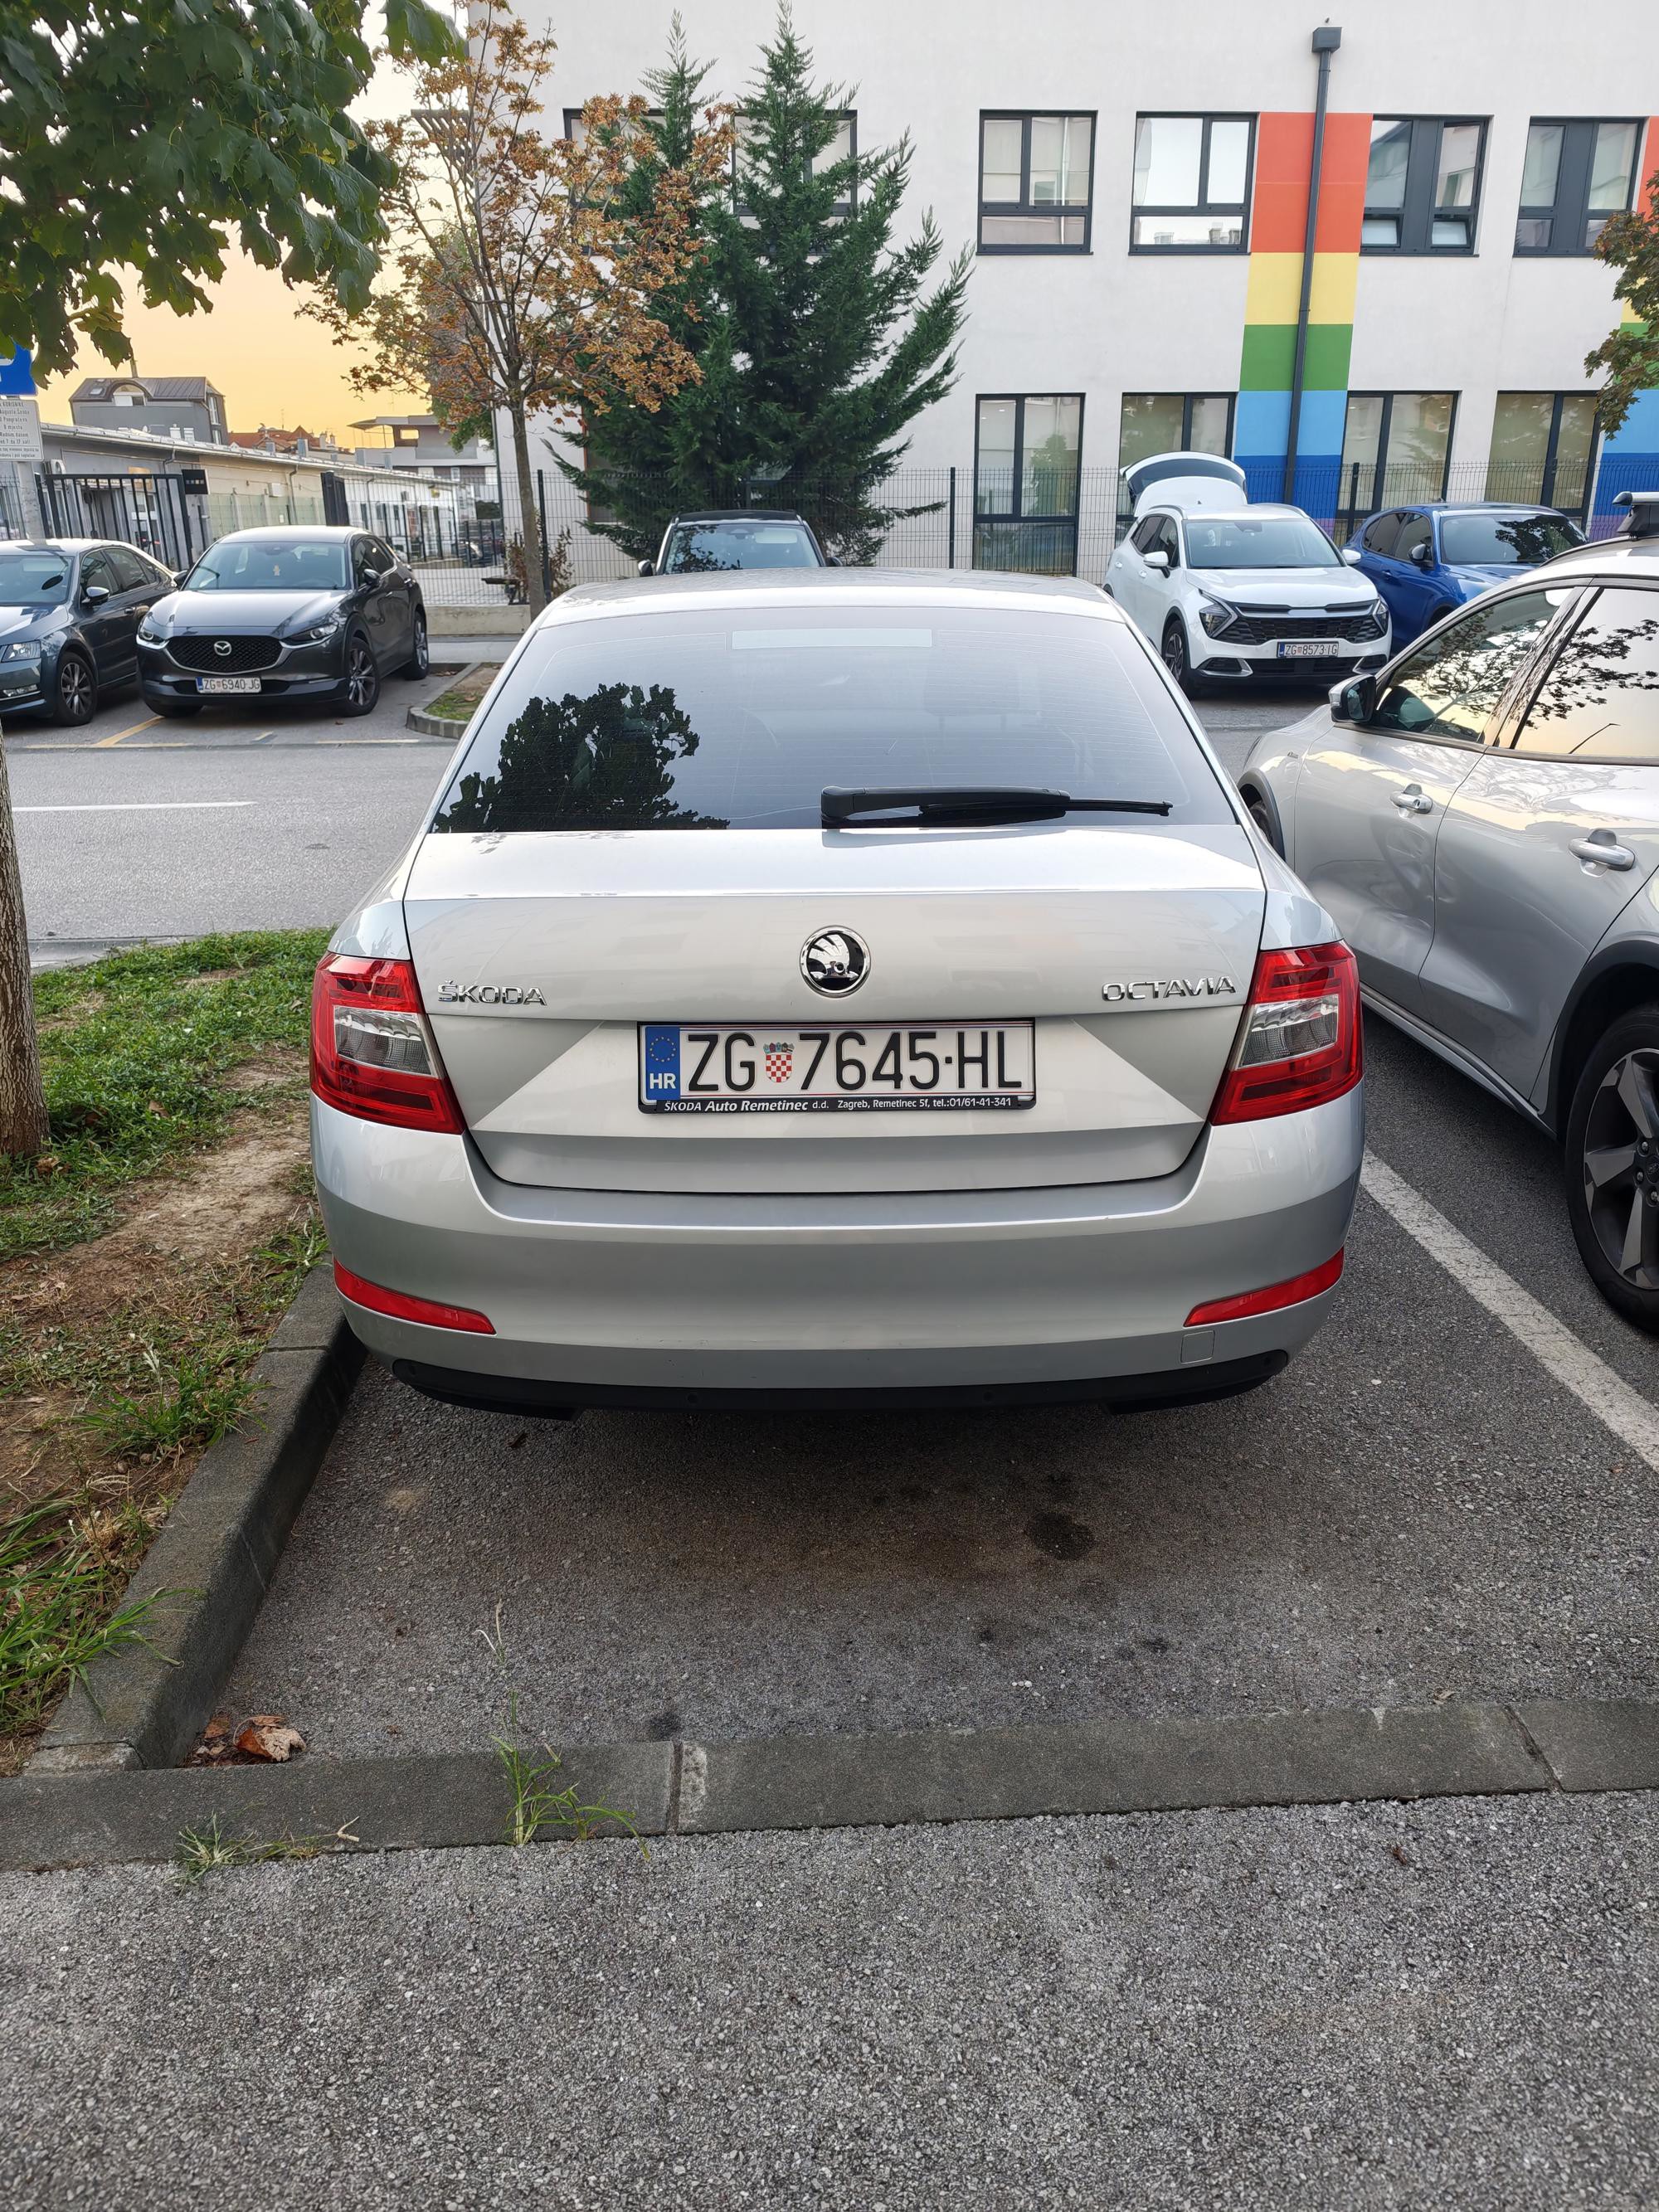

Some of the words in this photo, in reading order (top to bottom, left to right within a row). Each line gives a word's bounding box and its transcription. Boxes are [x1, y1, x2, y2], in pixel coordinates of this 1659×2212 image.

[1285, 644, 1297, 655] ZG
[204, 679, 216, 690] ZG
[437, 980, 547, 1006] ŠKODA
[1102, 975, 1237, 1001] OCTAVIA
[688, 1033, 756, 1091] ZG
[649, 1072, 676, 1089] HR
[664, 1101, 702, 1111] ŠKODA
[705, 1101, 737, 1112] Auto
[740, 1100, 808, 1111] Remetinec
[812, 1101, 830, 1109] d.d.
[837, 1099, 871, 1111] Zagreb,
[873, 1099, 917, 1108] Remetinec
